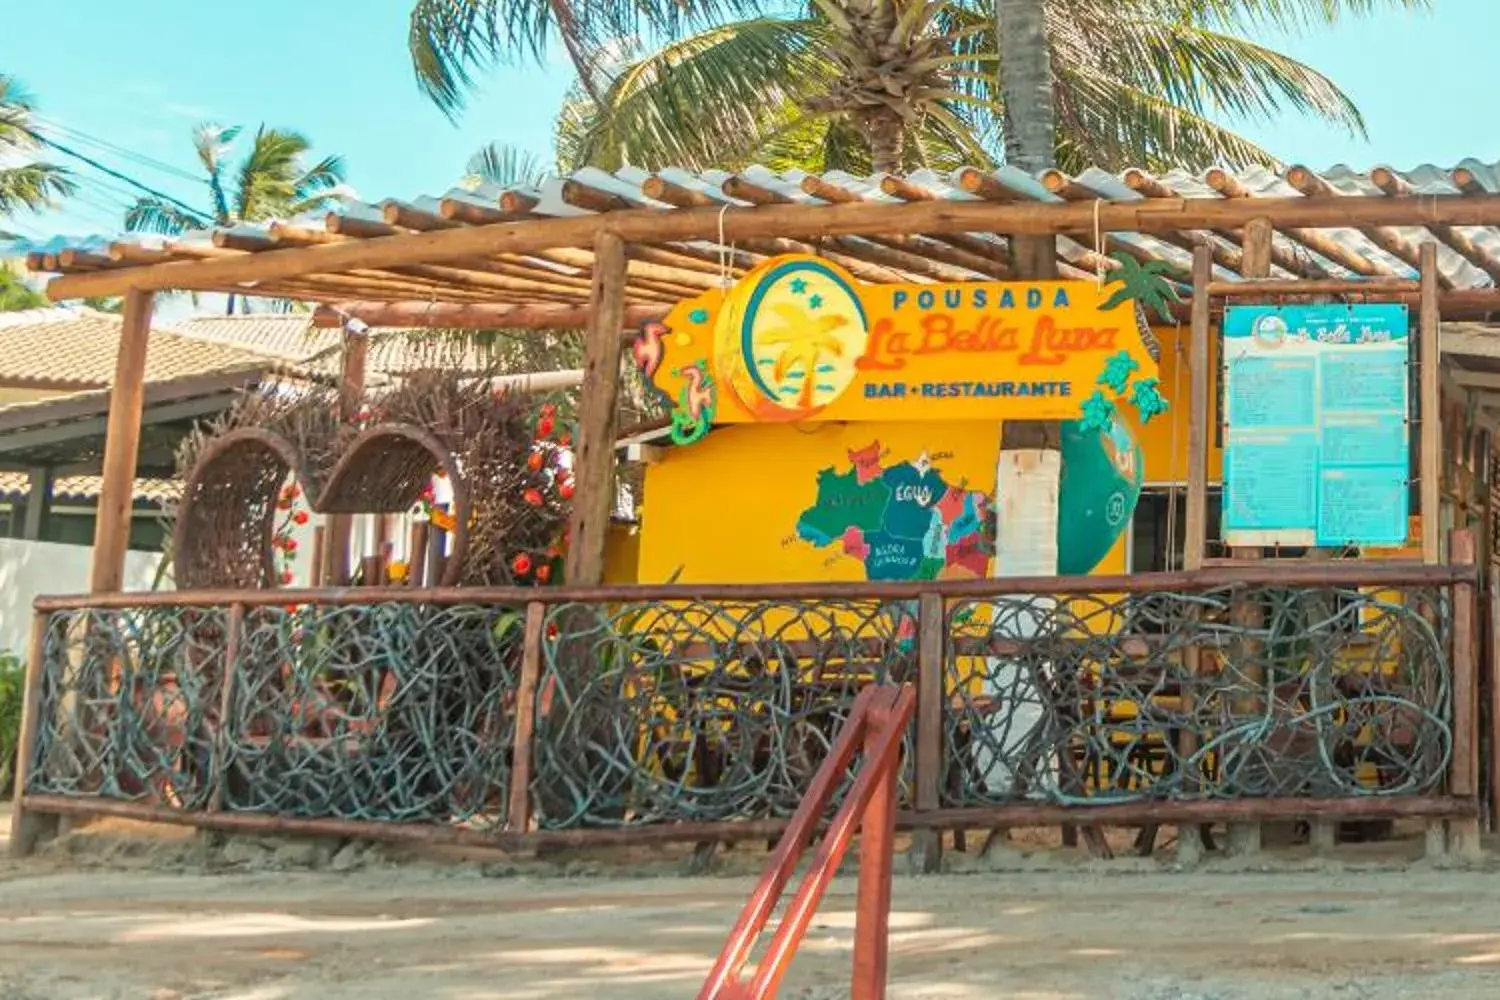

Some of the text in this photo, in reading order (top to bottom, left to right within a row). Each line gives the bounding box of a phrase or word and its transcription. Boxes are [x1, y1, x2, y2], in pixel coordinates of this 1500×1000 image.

[892, 287, 1070, 310] POUSADA
[854, 313, 1119, 370] La Bella Luna
[864, 380, 1072, 399] BAR RESTAURANTE
